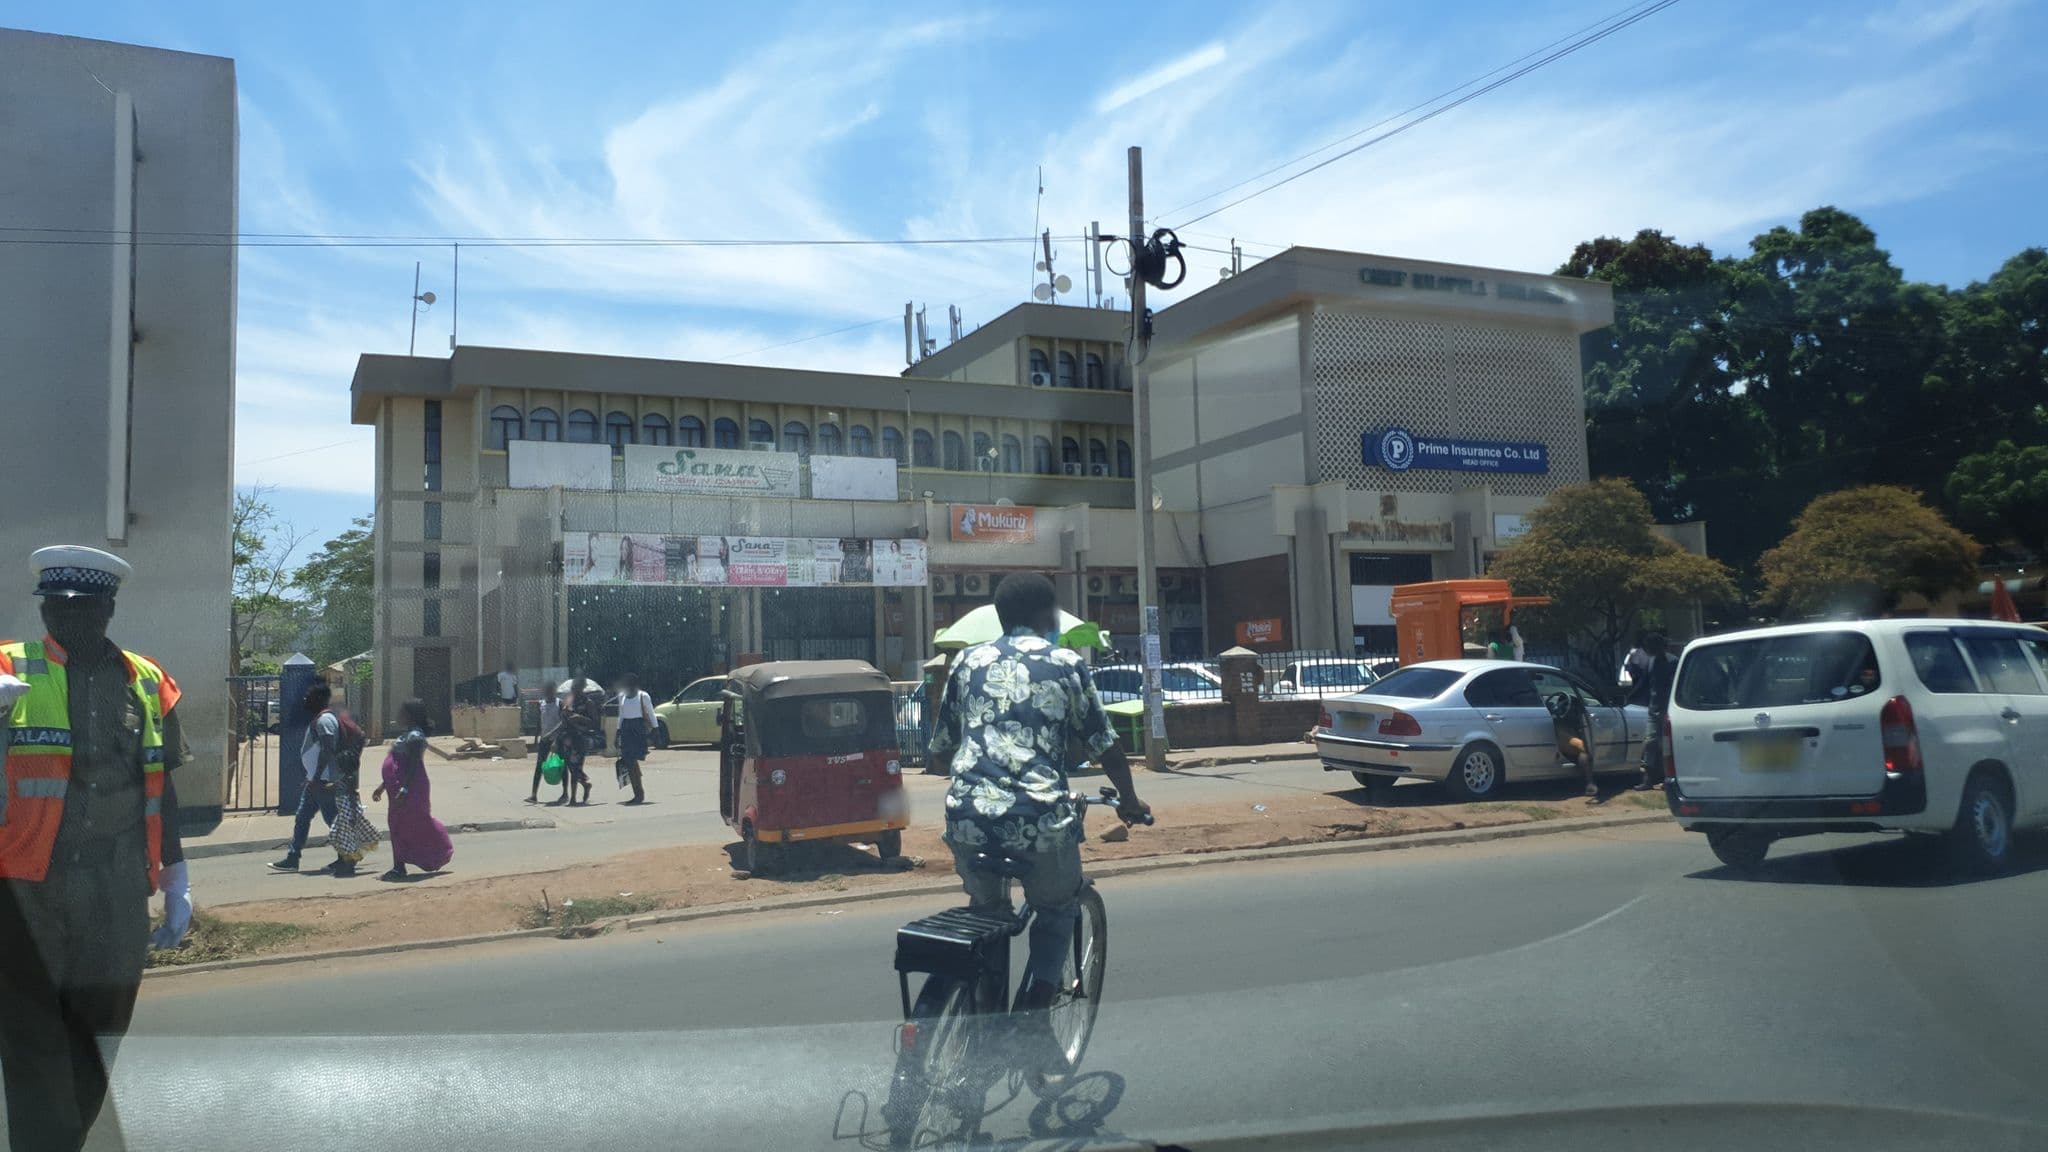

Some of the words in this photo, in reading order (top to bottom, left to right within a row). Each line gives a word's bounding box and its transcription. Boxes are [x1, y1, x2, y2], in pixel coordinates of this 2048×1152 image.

[1417, 441, 1449, 455] Prime
[1451, 444, 1502, 458] Insurance
[1503, 446, 1521, 459] Co.
[1523, 449, 1540, 460] Ltd
[656, 449, 760, 478] Sana
[1462, 458, 1479, 466] HEAD
[1479, 459, 1499, 467] OFFICE
[731, 538, 771, 553] Sana
[9, 730, 71, 744] ALAWI
